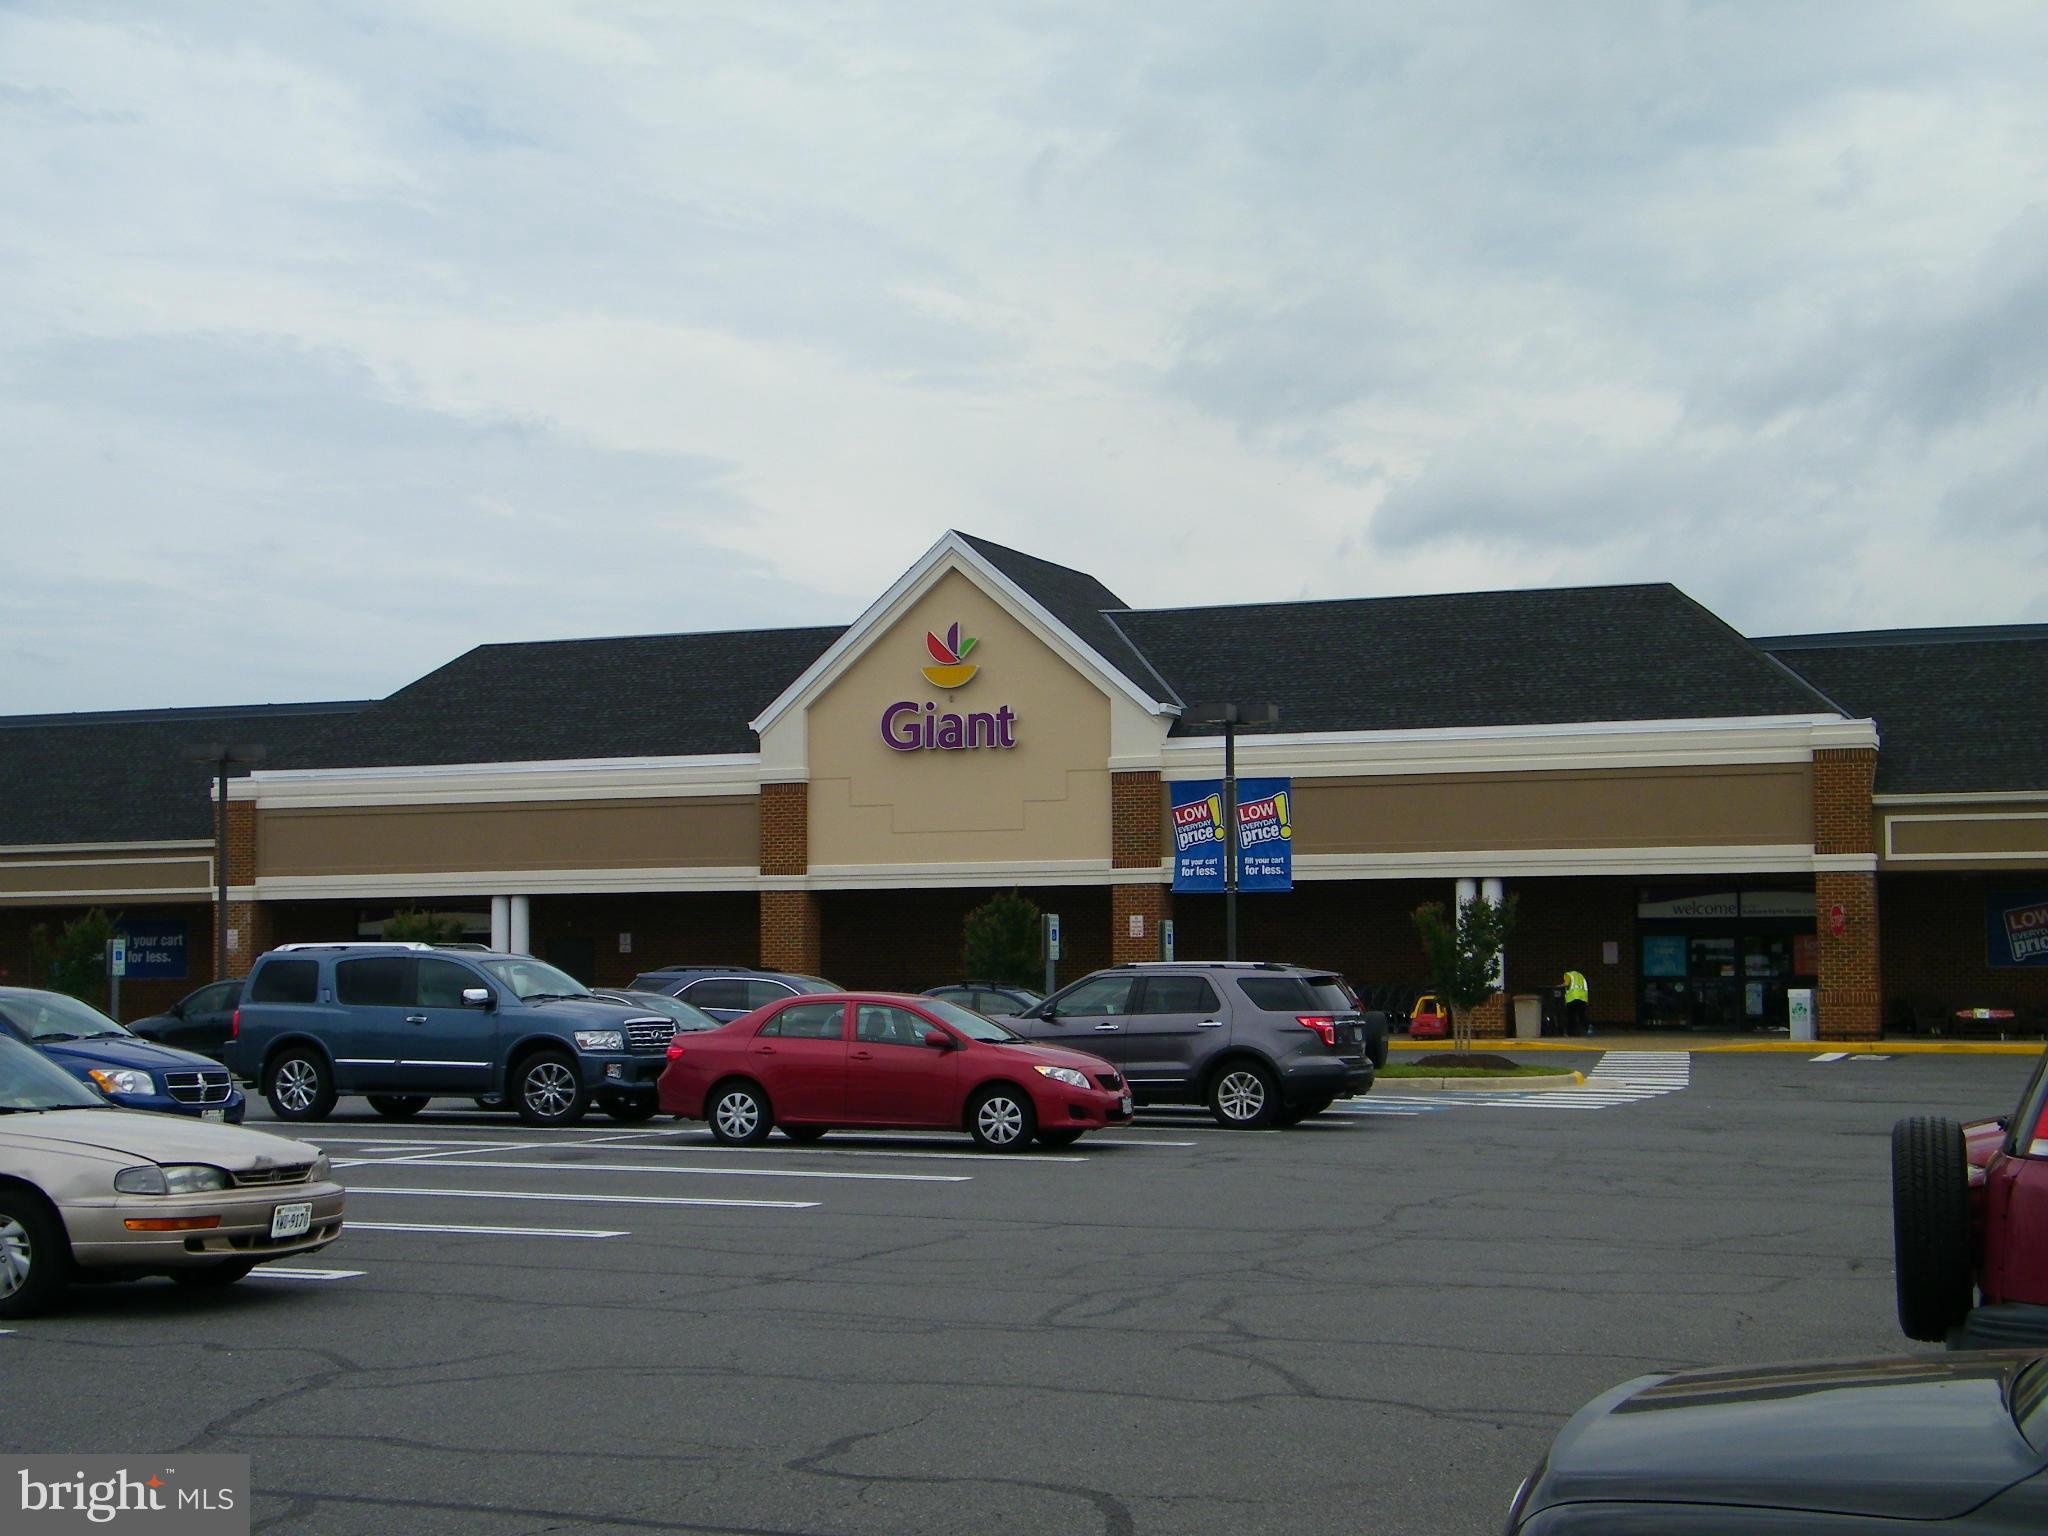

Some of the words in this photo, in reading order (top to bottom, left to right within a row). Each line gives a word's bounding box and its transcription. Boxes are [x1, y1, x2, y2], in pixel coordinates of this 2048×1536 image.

[880, 700, 1017, 751] Giant
[1176, 804, 1208, 824] LOW
[1239, 801, 1274, 822] LOW
[1177, 819, 1212, 833] EVERYDAY
[1241, 817, 1277, 831] EVERYDAY
[1181, 858, 1190, 866] fill
[1205, 857, 1218, 865] cart
[1254, 857, 1270, 865] your
[1271, 856, 1284, 864] cart
[1181, 867, 1194, 877] for
[1196, 866, 1218, 876] less.
[1245, 866, 1259, 875] for
[1261, 865, 1284, 875] less.
[1672, 900, 1737, 915] welcome
[2012, 927, 2048, 941] EVERYD
[133, 936, 159, 949] your
[160, 934, 184, 946] cart
[127, 950, 143, 963] for
[146, 950, 172, 963] less.
